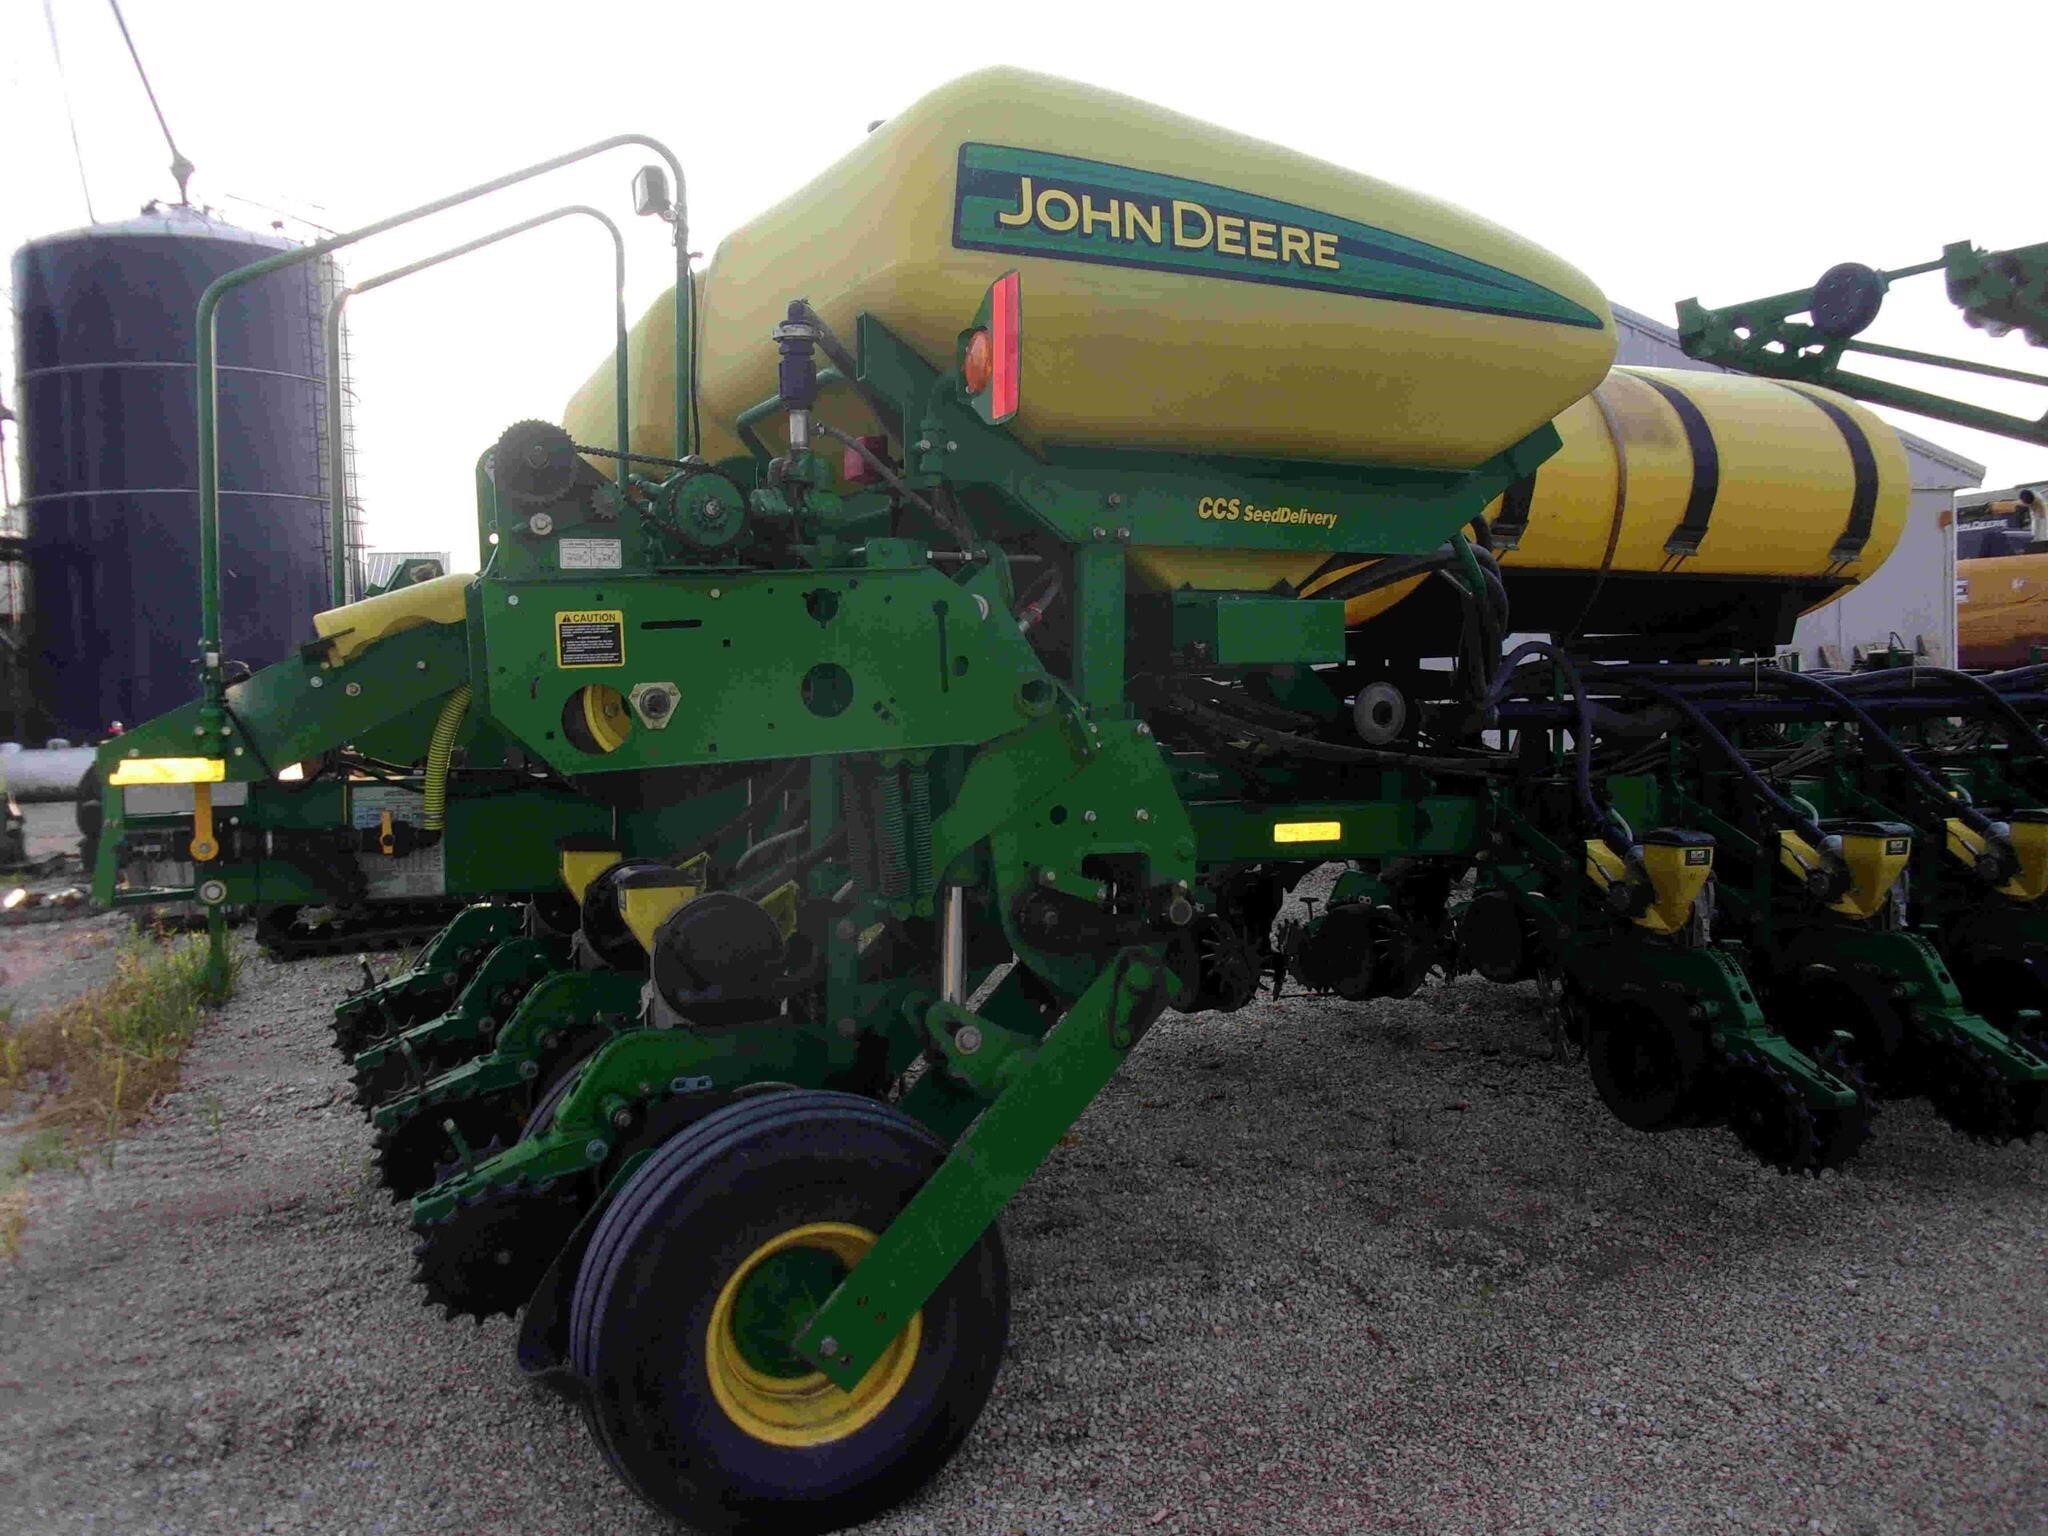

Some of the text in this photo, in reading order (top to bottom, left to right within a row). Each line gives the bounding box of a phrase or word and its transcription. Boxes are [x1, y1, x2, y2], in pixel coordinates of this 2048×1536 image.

[1000, 177, 1340, 269] JOHN DEERE
[1199, 497, 1337, 529] CCS SeedDelivery
[573, 613, 616, 622] CAUTION
